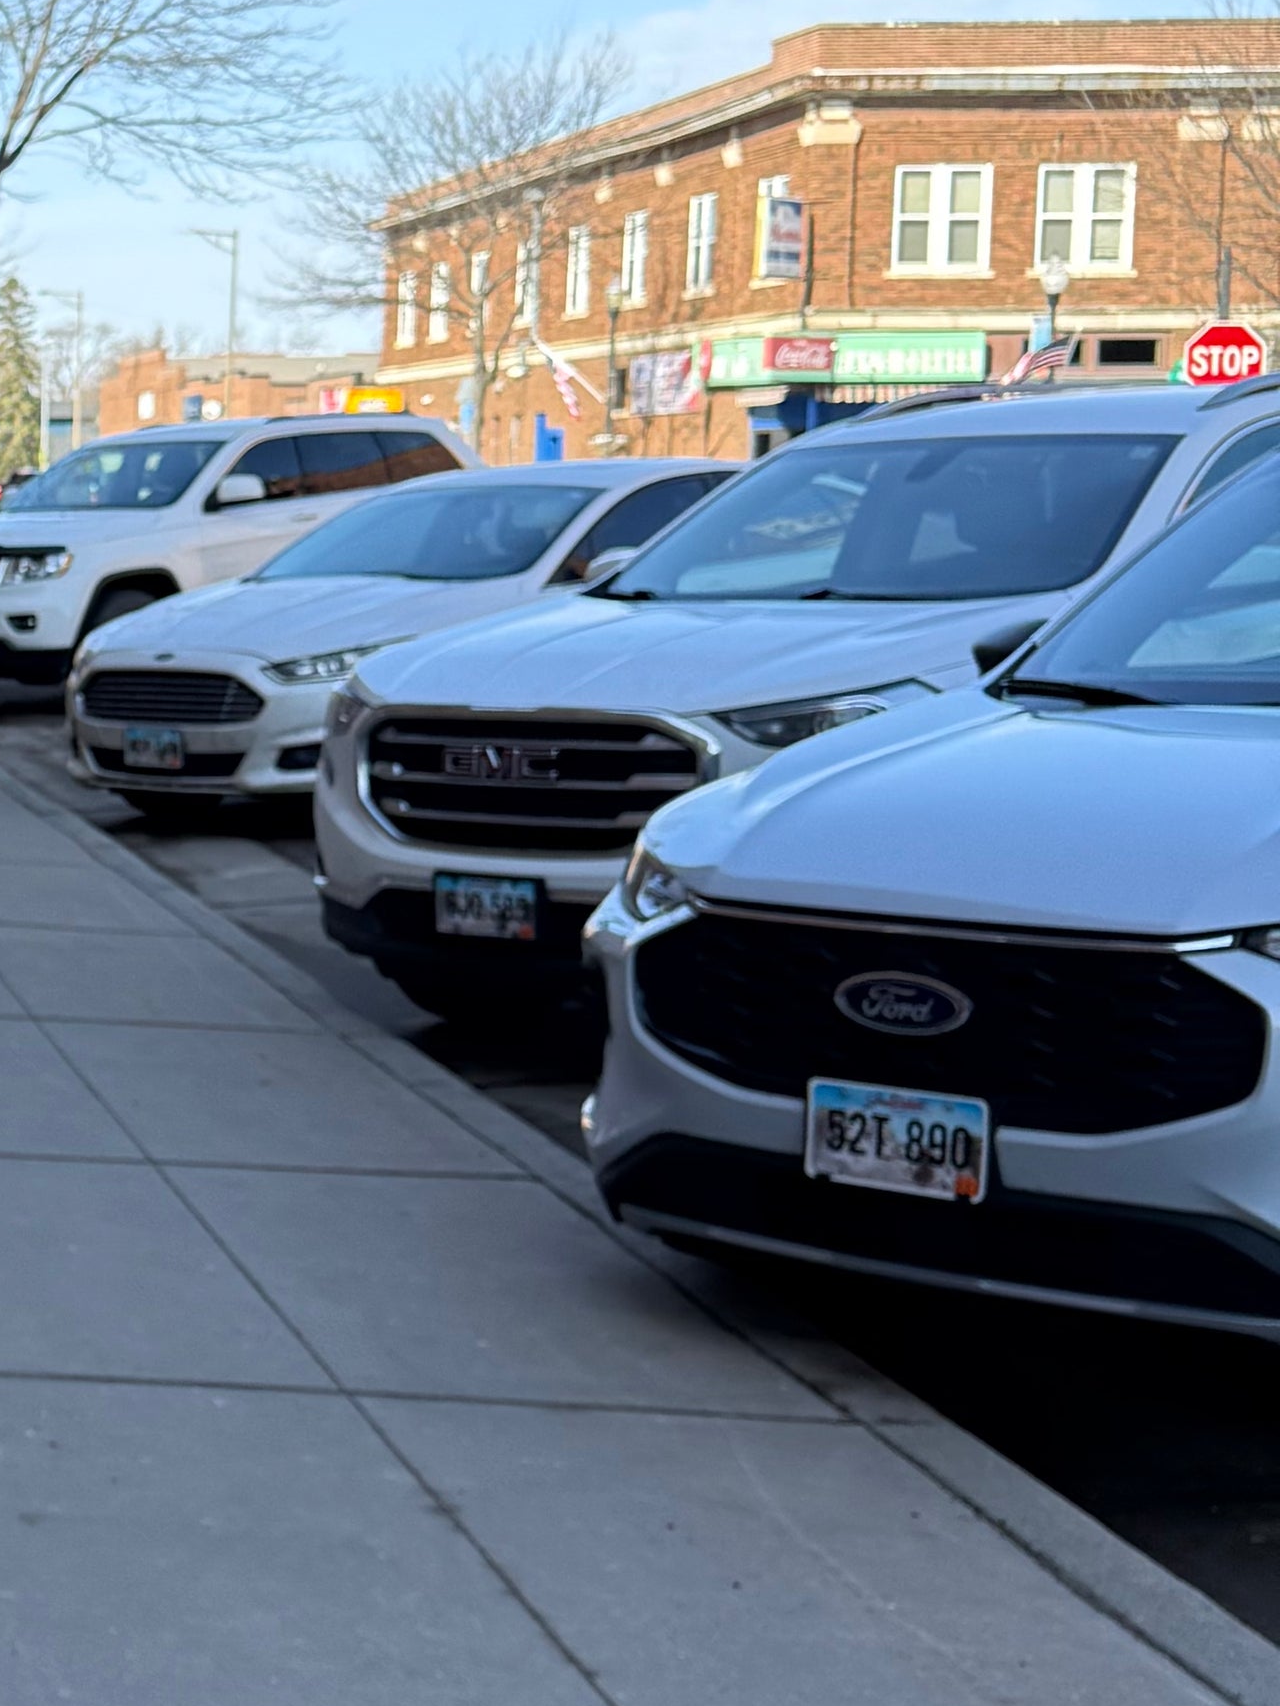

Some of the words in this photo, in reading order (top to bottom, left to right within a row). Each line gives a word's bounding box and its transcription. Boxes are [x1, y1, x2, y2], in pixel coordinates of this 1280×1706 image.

[1190, 344, 1260, 377] STOP
[444, 744, 559, 779] GMC
[861, 983, 934, 1022] Ford
[826, 1109, 890, 1158] 52T
[905, 1119, 972, 1169] 890
